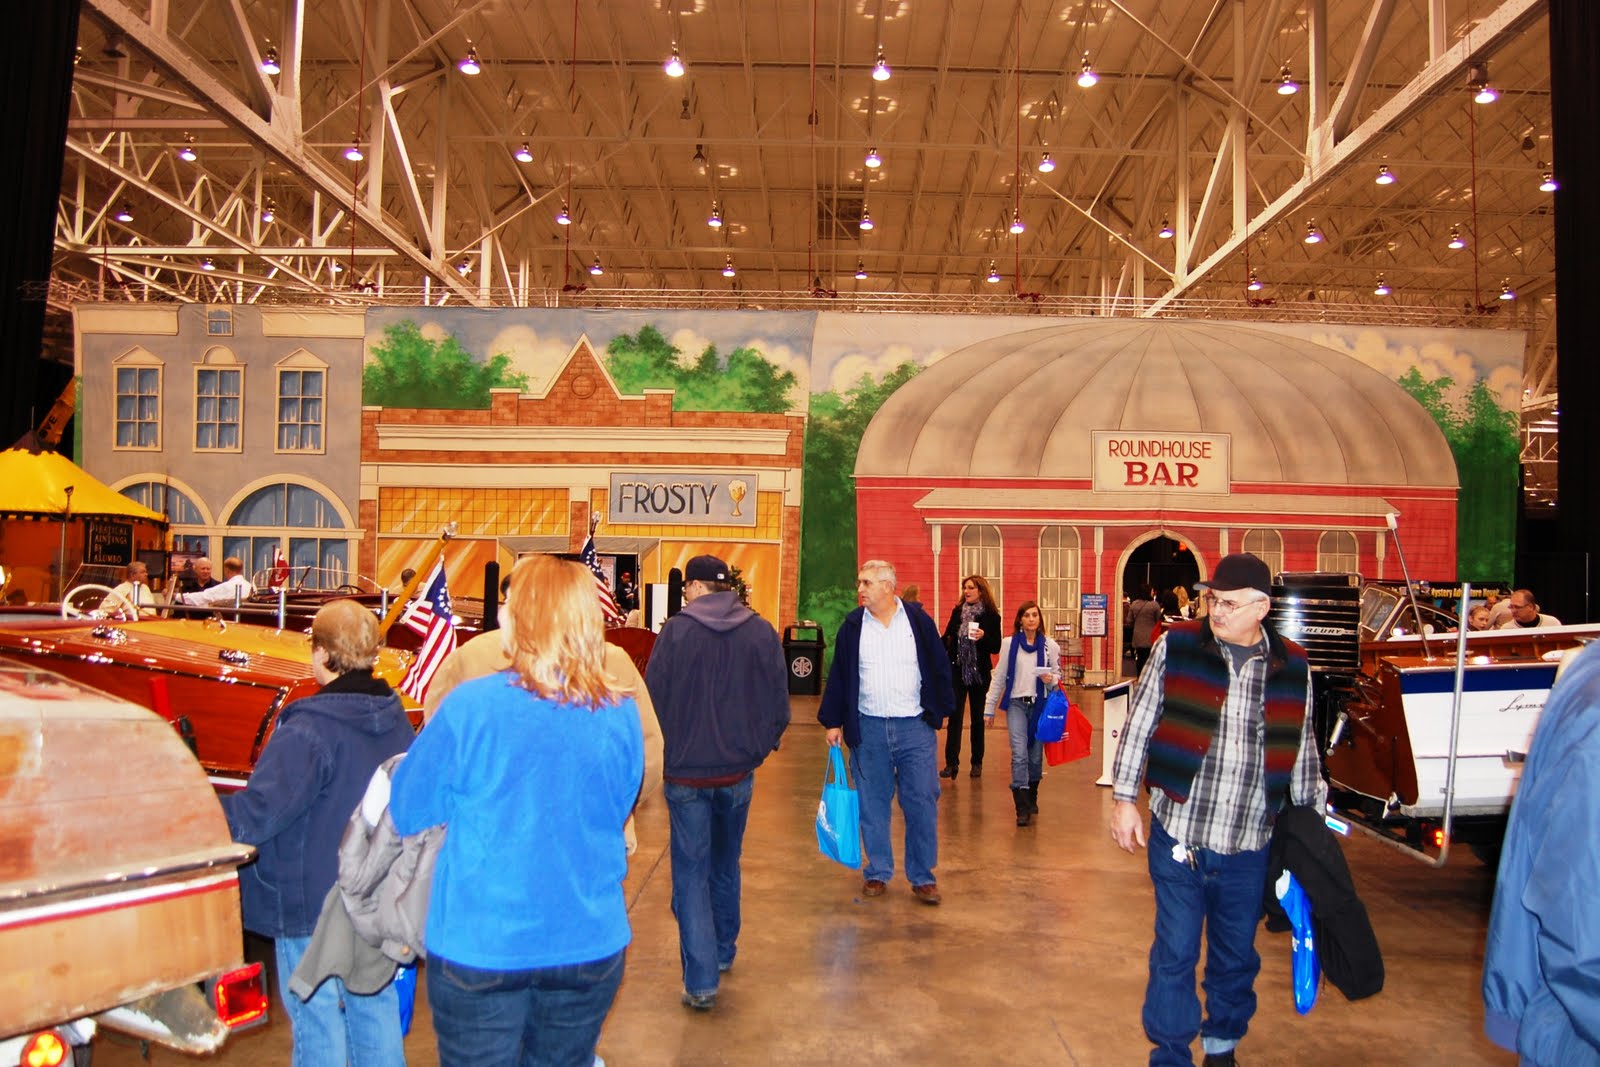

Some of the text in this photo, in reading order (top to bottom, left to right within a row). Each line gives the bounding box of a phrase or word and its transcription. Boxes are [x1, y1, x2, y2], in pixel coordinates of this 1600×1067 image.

[1108, 439, 1212, 459] ROUNDHOUSE
[1123, 461, 1199, 488] BAR
[618, 481, 718, 515] FROSTY
